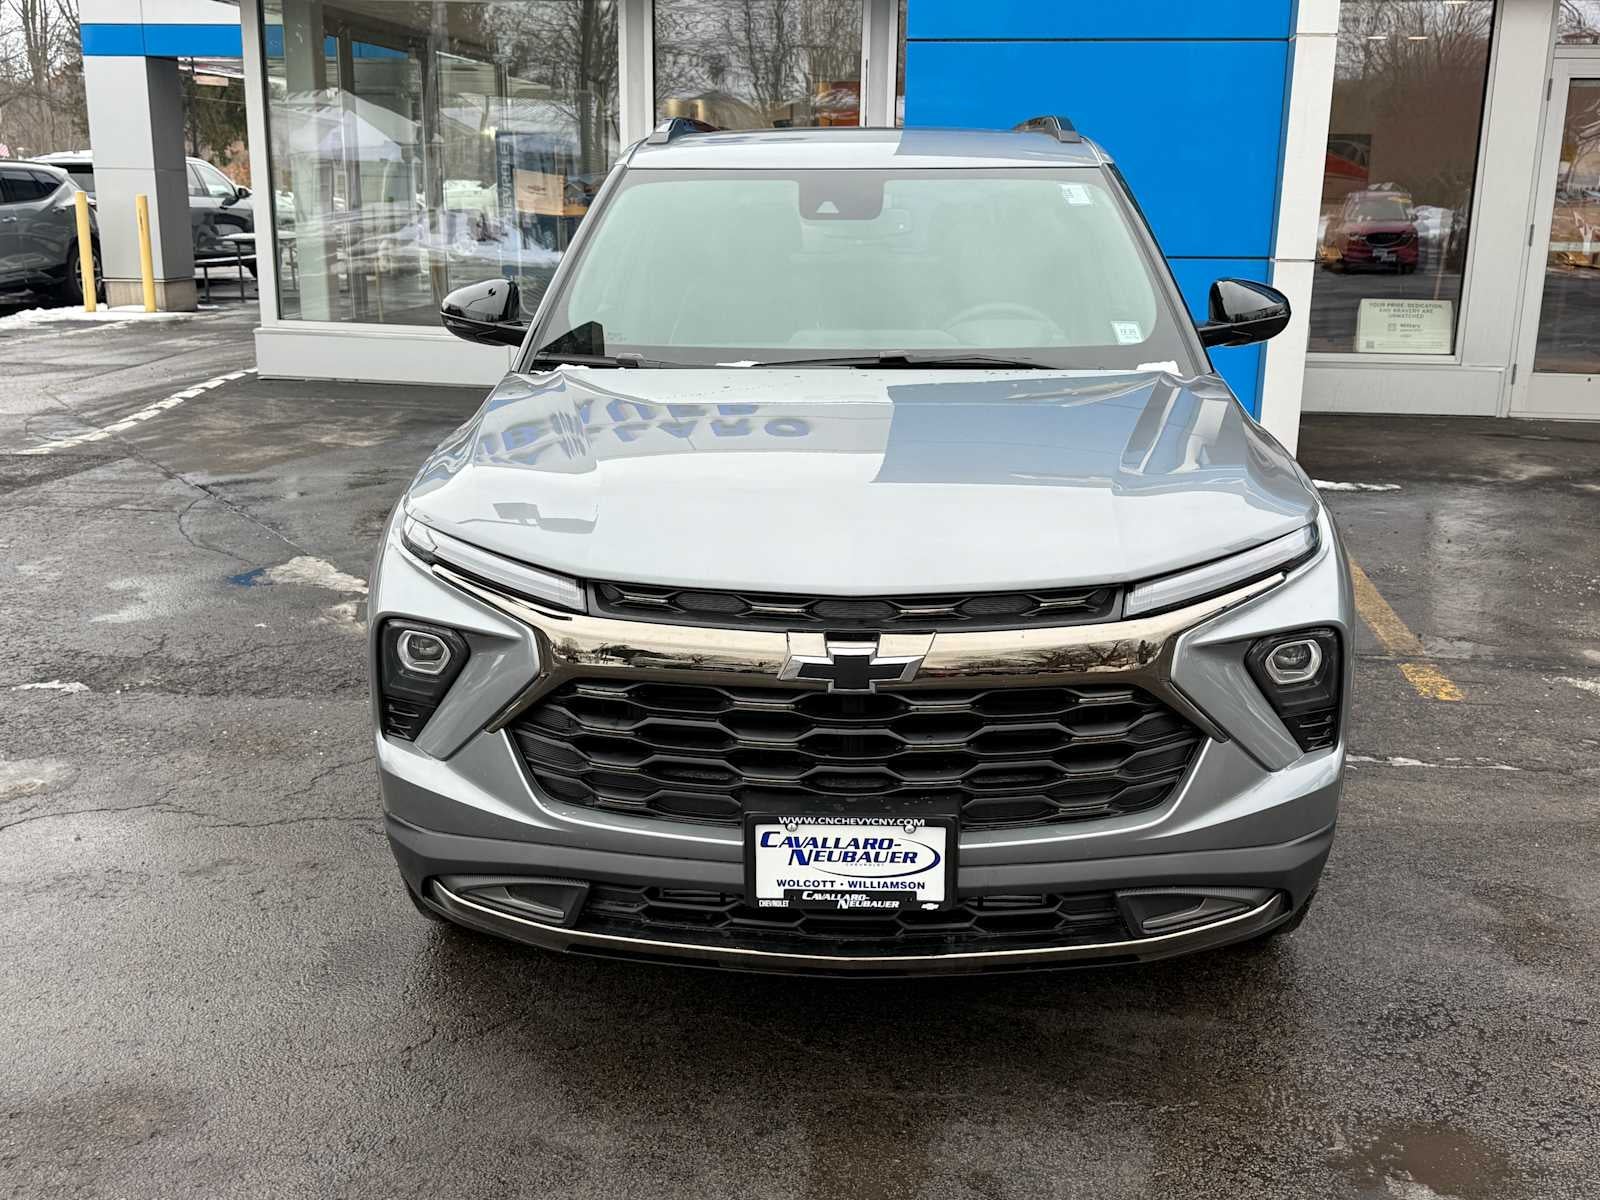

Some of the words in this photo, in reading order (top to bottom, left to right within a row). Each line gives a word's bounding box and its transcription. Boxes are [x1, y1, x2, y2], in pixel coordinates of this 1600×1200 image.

[778, 816, 926, 827] WWW.CNCHEVYCNY.COM
[760, 831, 902, 850] CAVALLARO-
[787, 849, 918, 866] NEUBAUER
[776, 879, 836, 889] WOLCOTT
[848, 880, 926, 890] WILLIAMSON
[802, 890, 871, 901] CAVALLARO-
[836, 898, 900, 909] NEUBAUER
